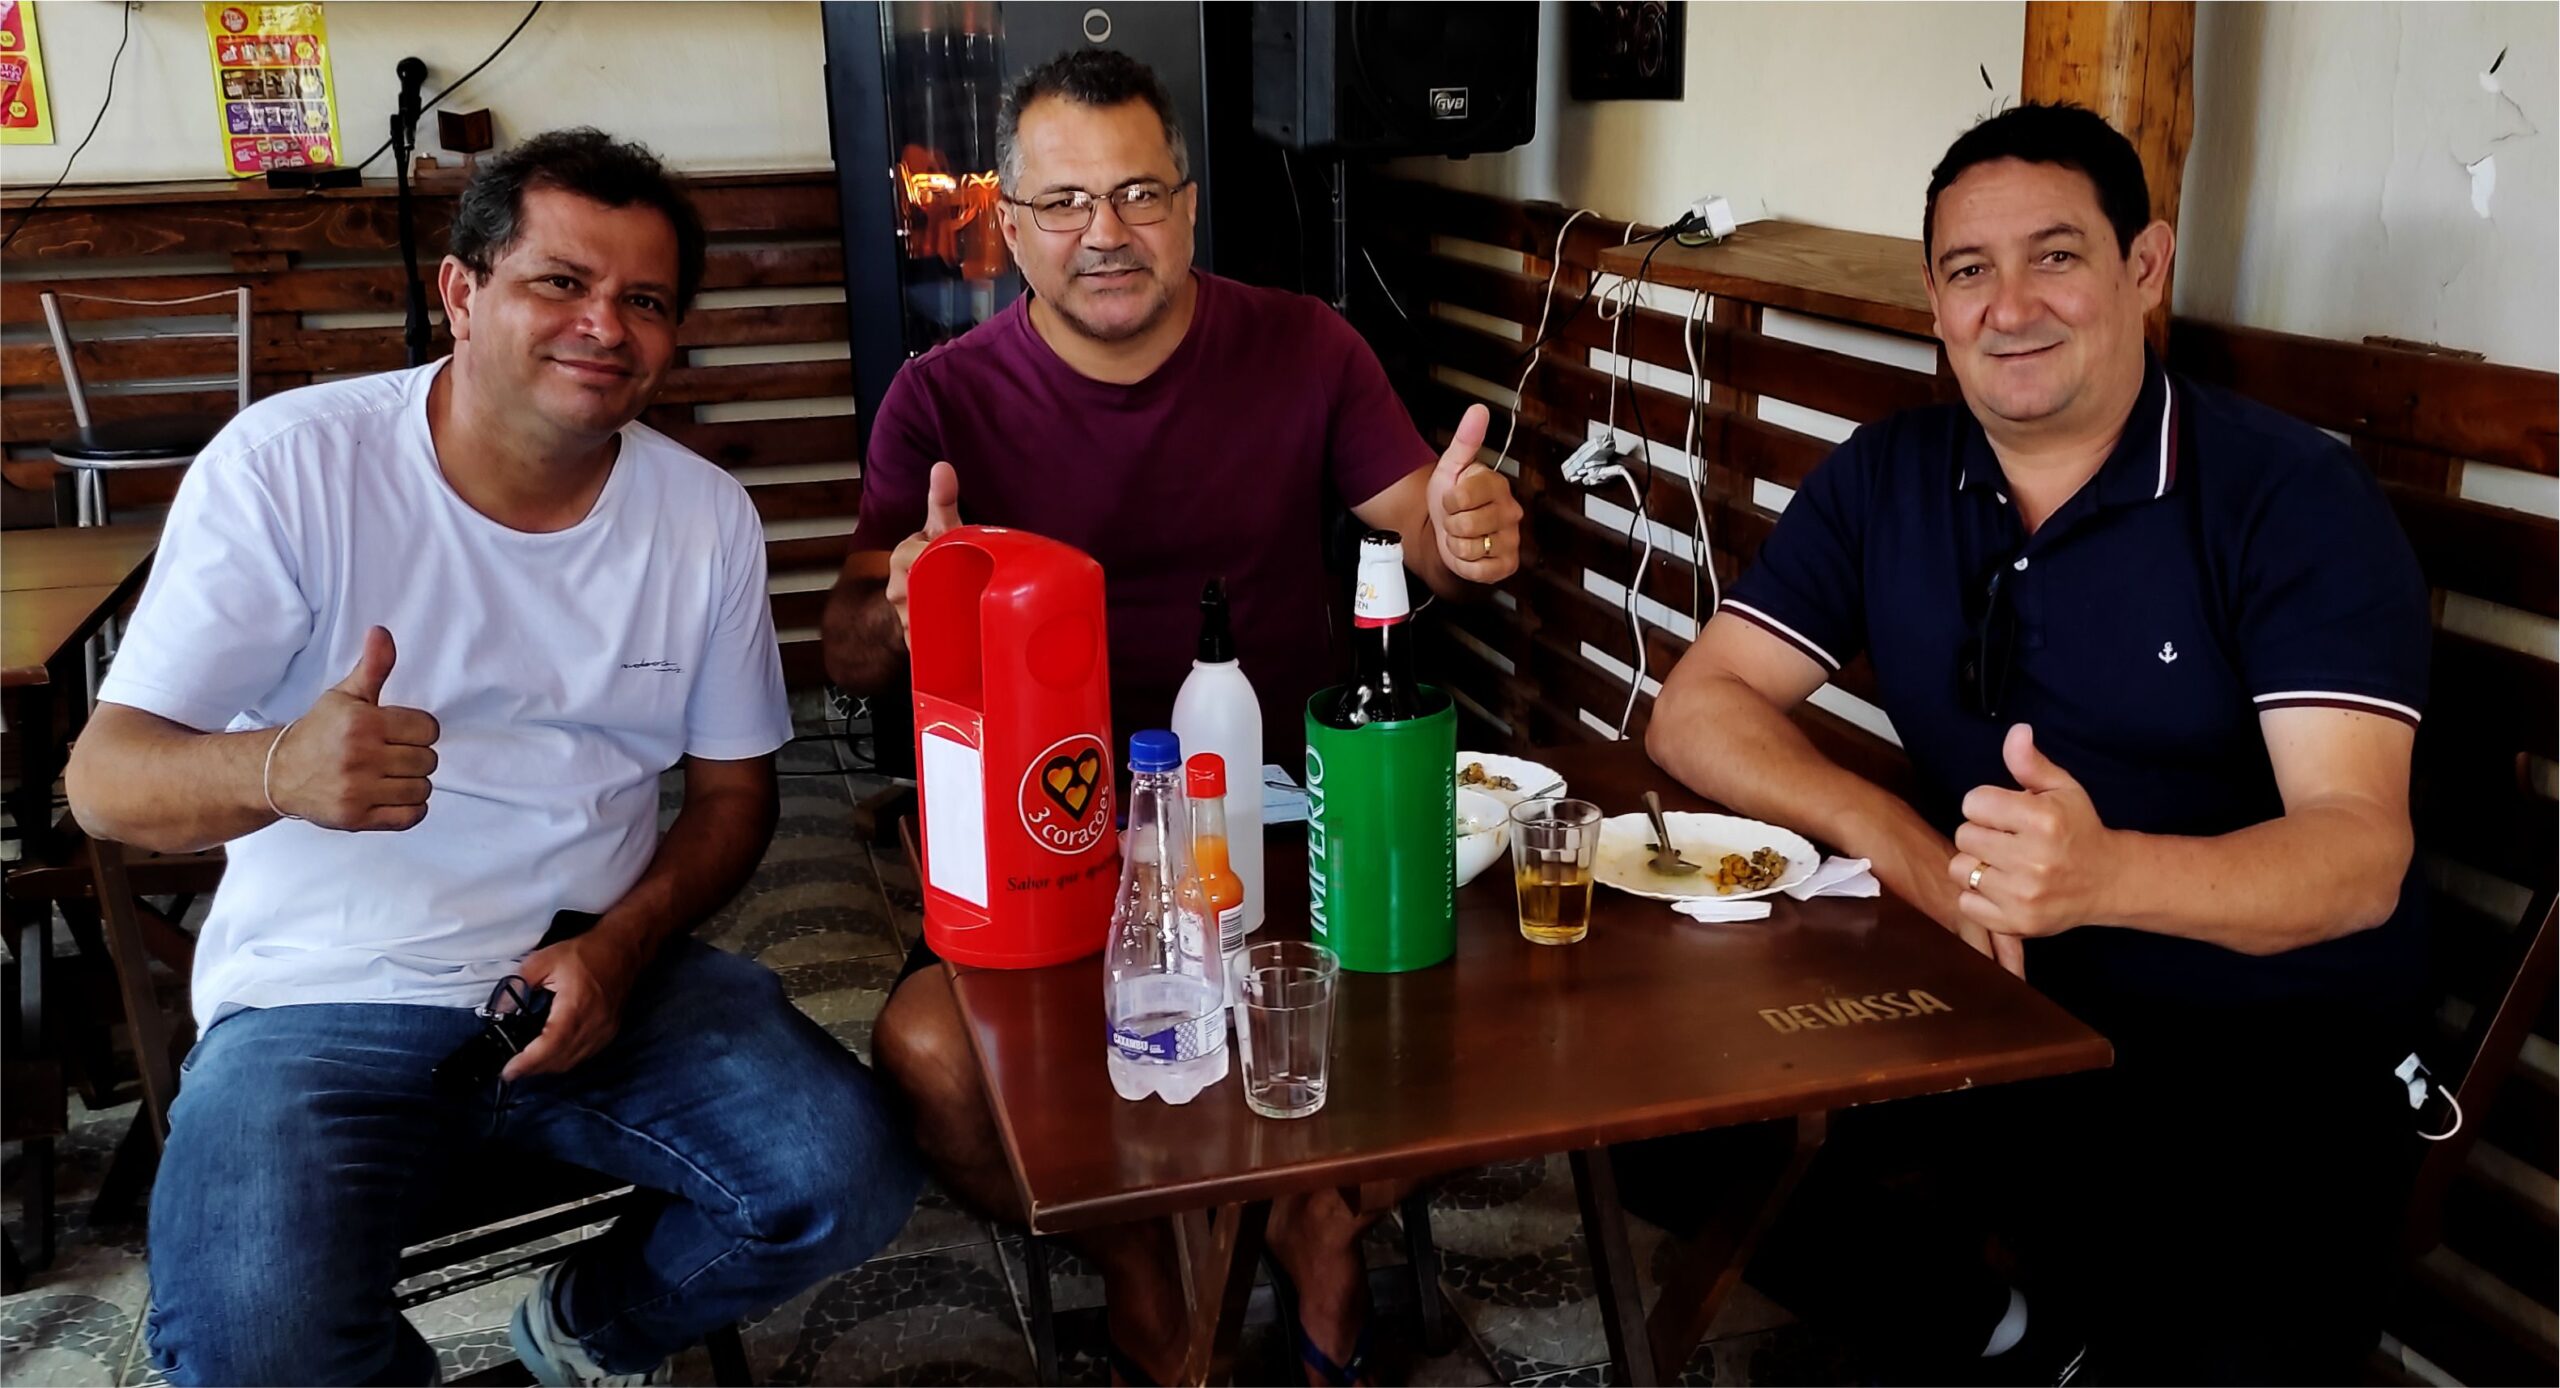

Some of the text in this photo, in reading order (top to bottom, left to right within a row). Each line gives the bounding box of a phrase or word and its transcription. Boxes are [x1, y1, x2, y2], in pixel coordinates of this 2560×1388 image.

[1028, 785, 1110, 846] 3 corações
[1757, 988, 1954, 1035] DEVASSA
